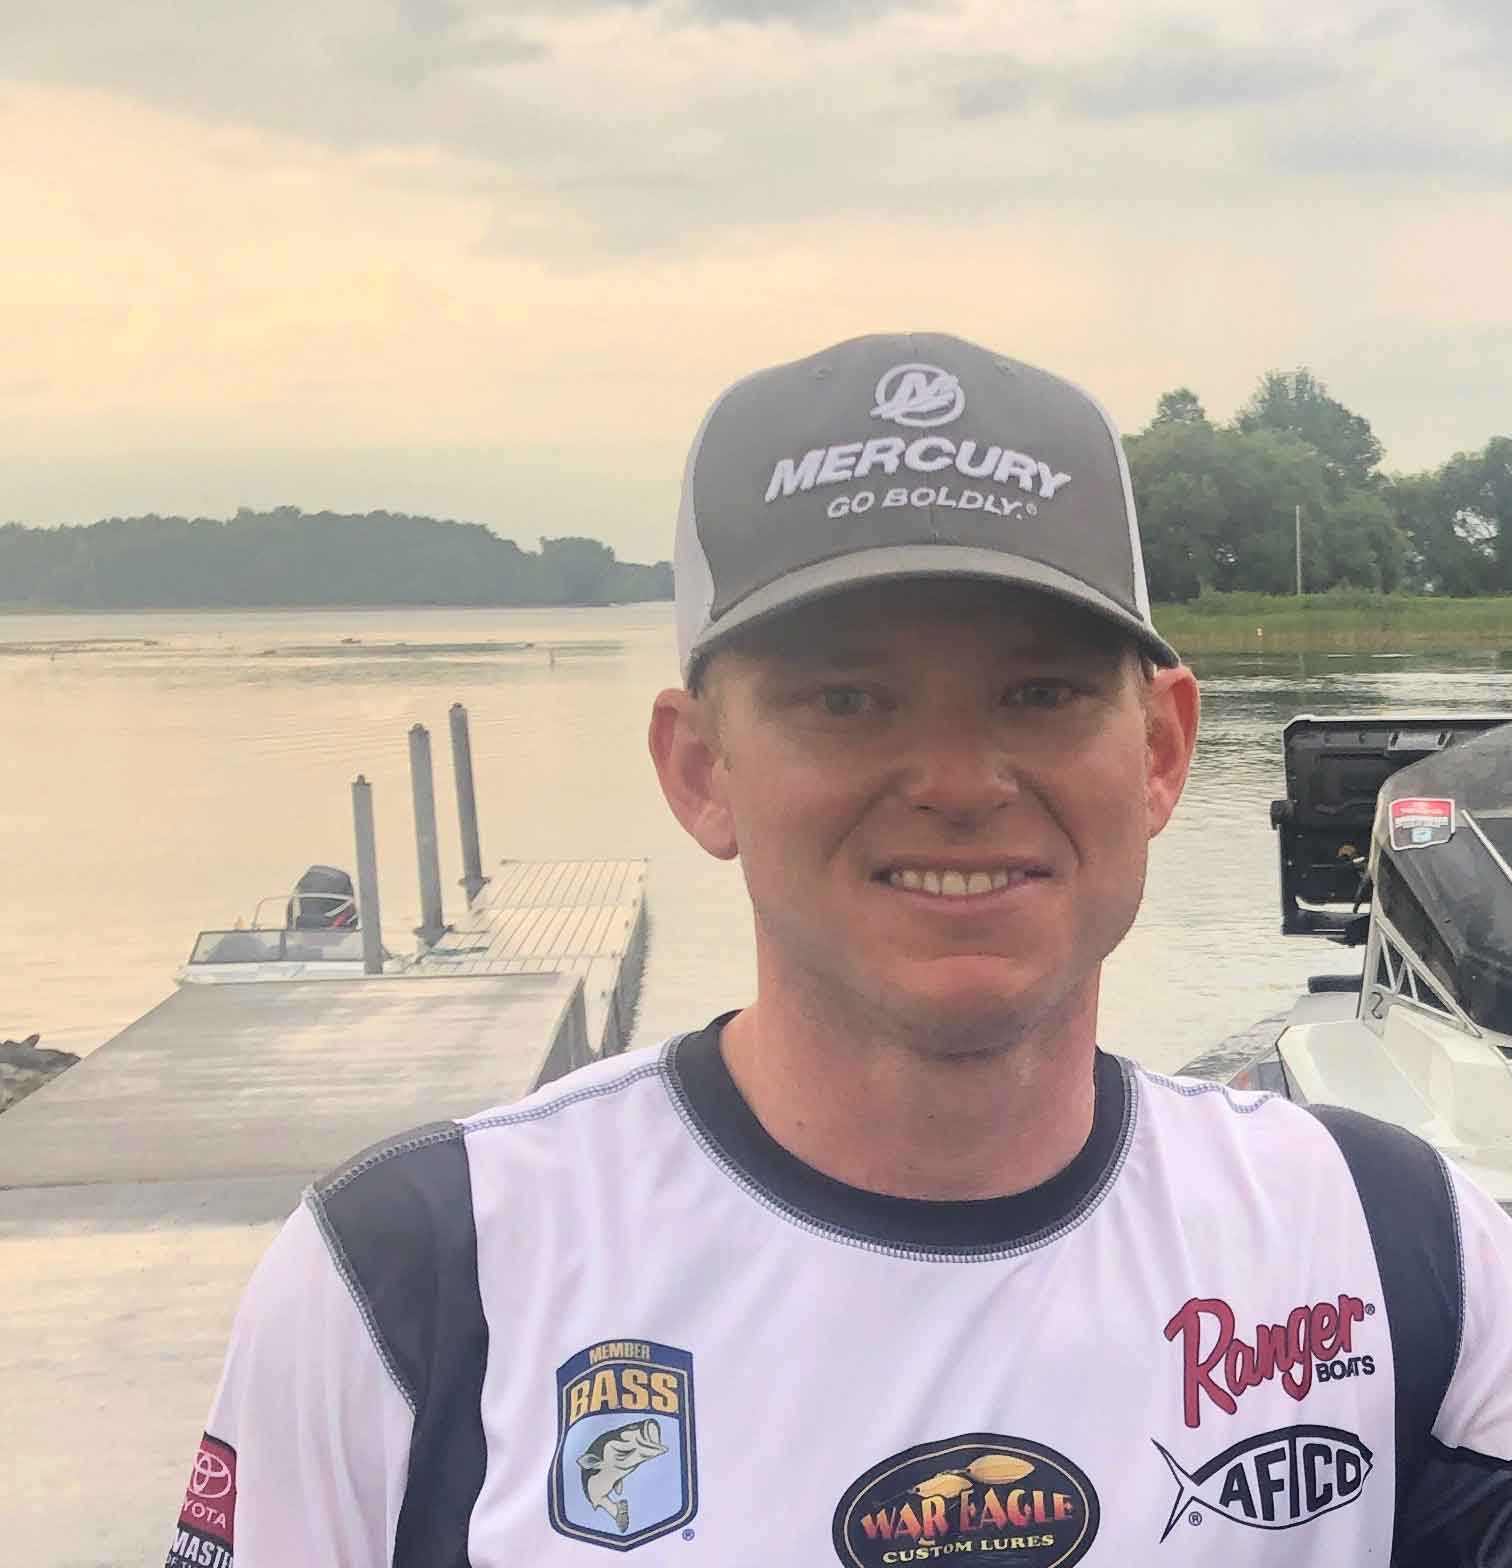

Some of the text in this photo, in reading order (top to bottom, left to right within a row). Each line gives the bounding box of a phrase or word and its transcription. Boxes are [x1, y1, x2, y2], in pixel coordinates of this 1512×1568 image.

[764, 436, 1072, 503] MERCURY
[826, 490, 876, 518] GO
[588, 1342, 651, 1364] MEMBER
[1163, 1294, 1365, 1429] Ranger
[1315, 1355, 1376, 1383] BOATS
[1218, 1438, 1362, 1522] AFICO
[860, 1487, 1074, 1541] WAR EAGLE
[882, 1534, 1055, 1564] CUSTOM LURES
